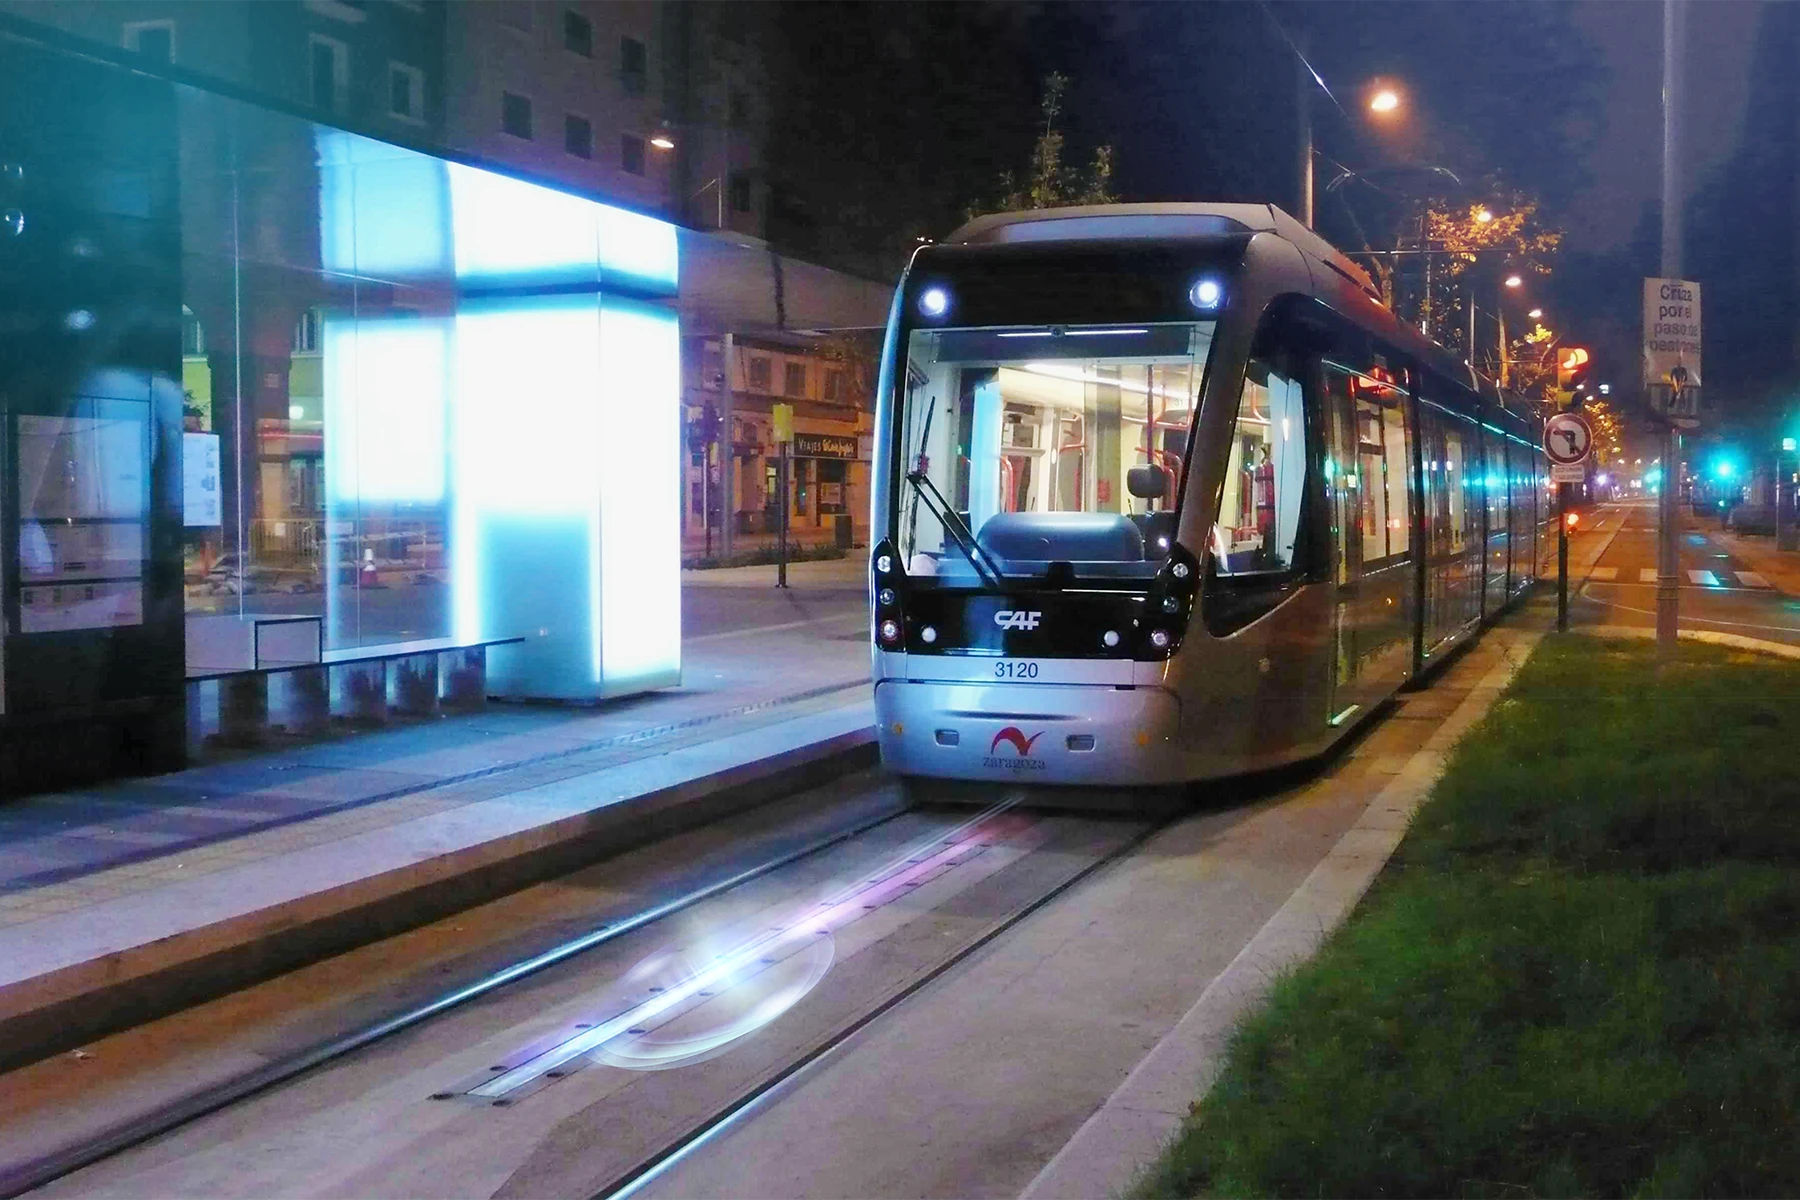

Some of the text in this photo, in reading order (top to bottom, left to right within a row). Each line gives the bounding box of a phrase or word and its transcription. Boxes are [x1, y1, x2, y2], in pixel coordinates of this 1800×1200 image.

[1660, 285, 1692, 302] Cruza
[1659, 306, 1683, 320] por
[1654, 323, 1686, 338] paso
[993, 610, 1042, 631] CAF
[994, 661, 1039, 678] 3120
[982, 757, 1046, 773] zaragoza
